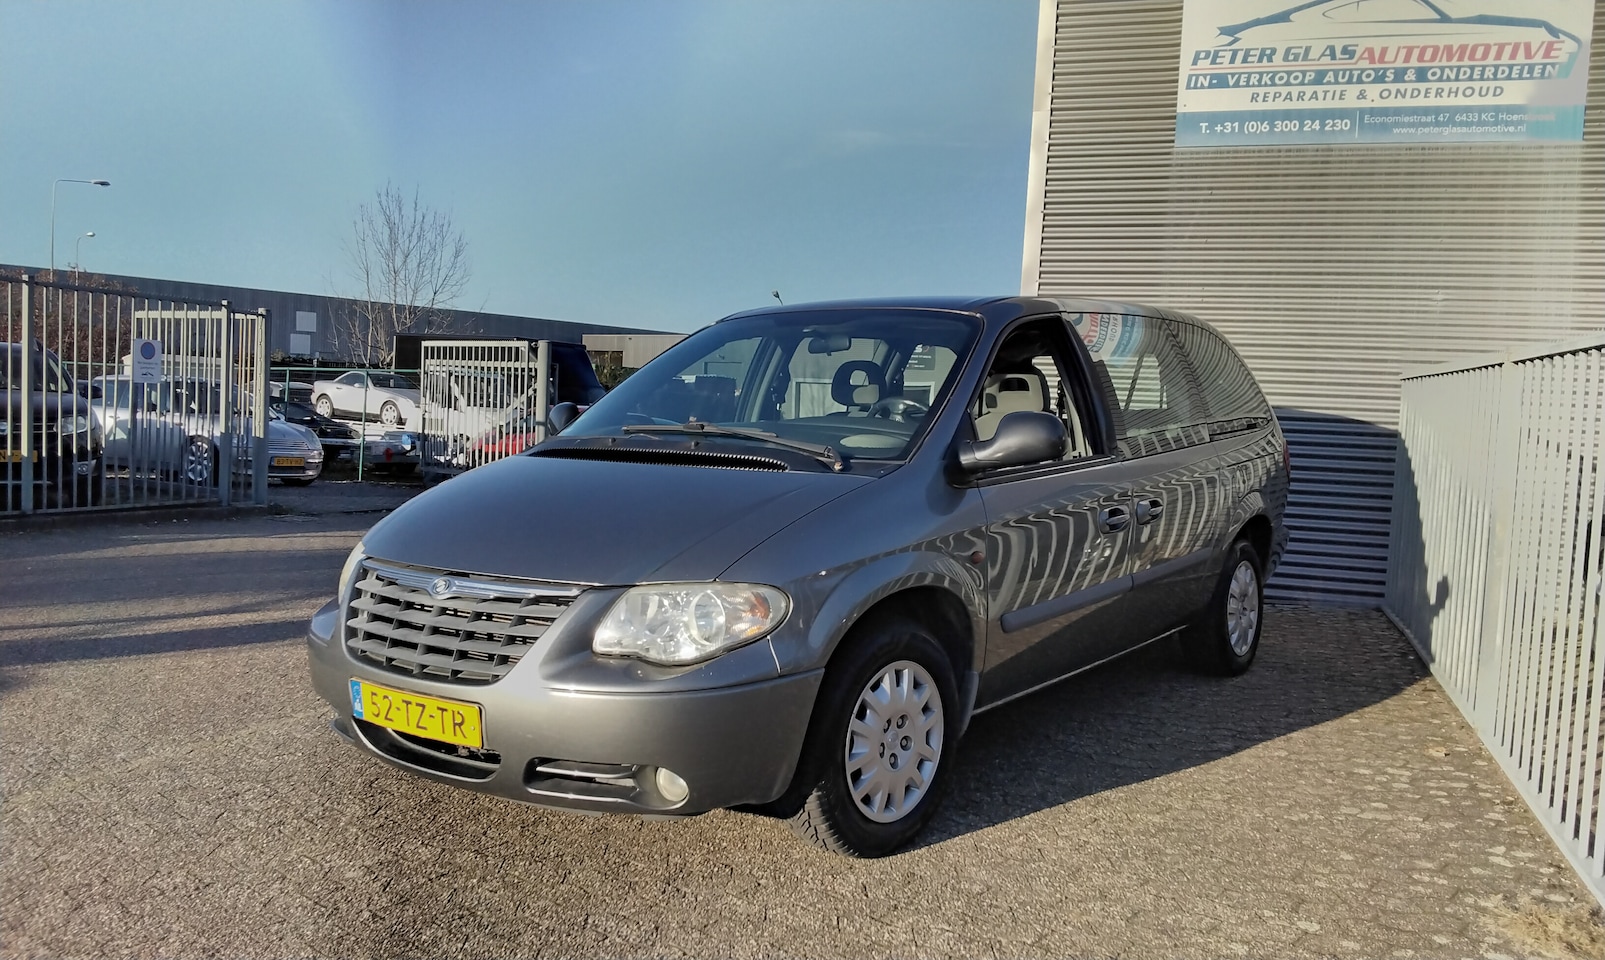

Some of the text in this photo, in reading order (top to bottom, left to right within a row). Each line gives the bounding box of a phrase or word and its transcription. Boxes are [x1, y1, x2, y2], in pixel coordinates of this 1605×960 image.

[1191, 47, 1277, 66] PETER
[1190, 63, 1560, 88] IN- VERKOOP AUTO'S & ONDERDELEN
[1250, 85, 1505, 103] REPARATIE & ONDERHOUD
[1200, 118, 1351, 135] T. +31 (0)6 300 24 230
[1364, 114, 1436, 124] Economiestraat
[1438, 113, 1450, 122] 47
[1455, 113, 1479, 122] 6433
[1481, 112, 1496, 122] KC
[1393, 124, 1527, 136] www.peterglasautomotive.nl
[370, 691, 467, 739] 52-TZ-TR
